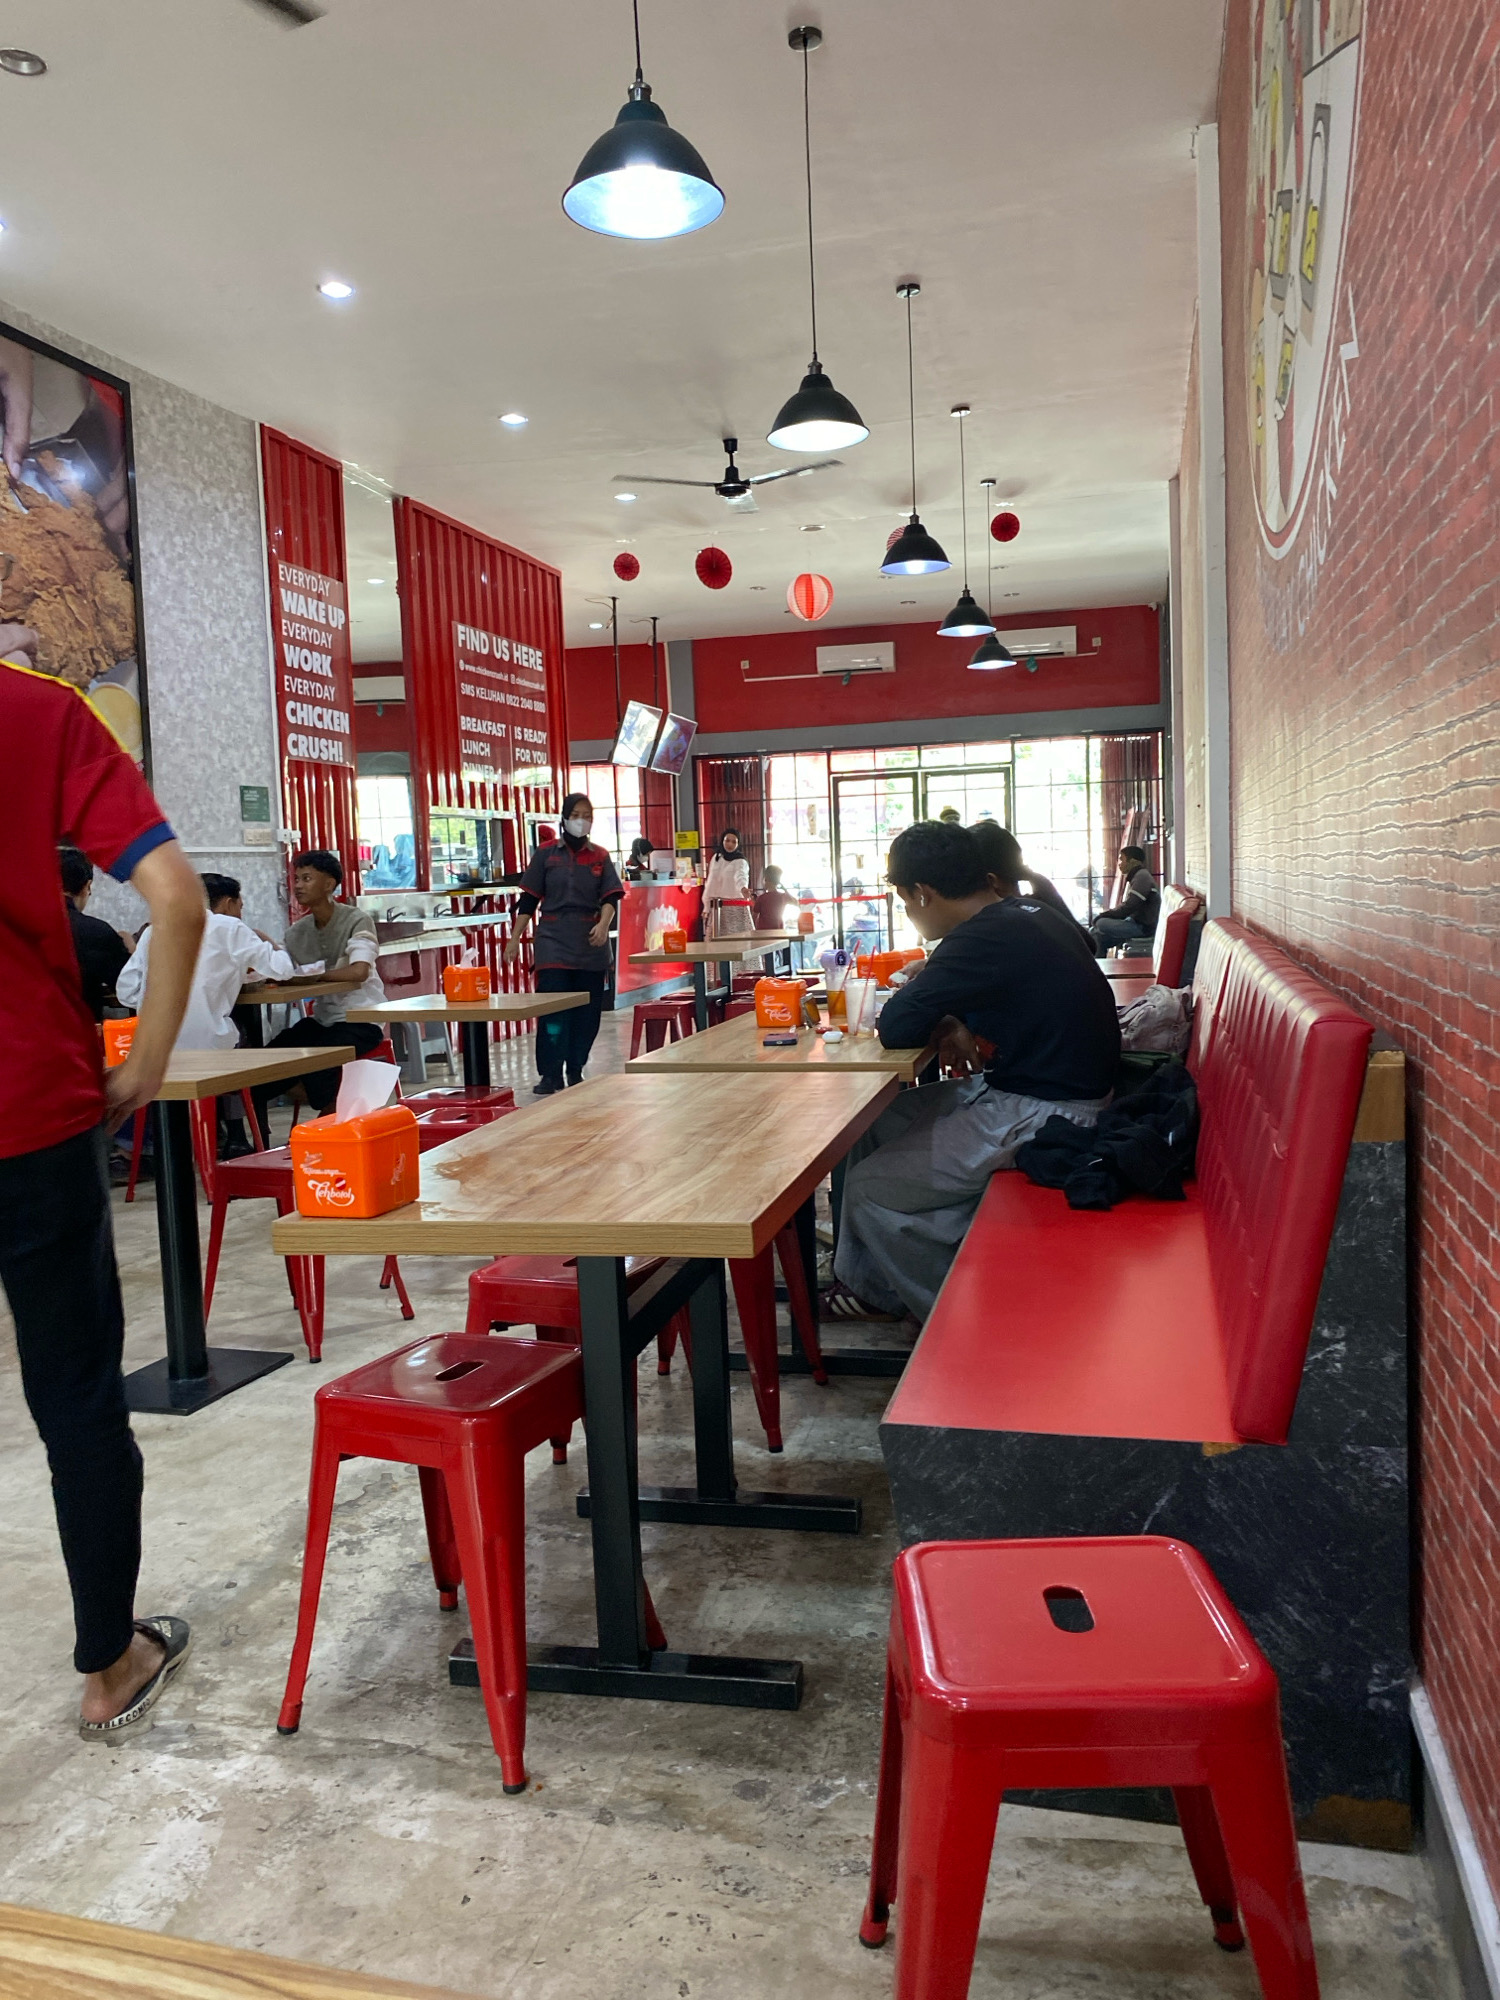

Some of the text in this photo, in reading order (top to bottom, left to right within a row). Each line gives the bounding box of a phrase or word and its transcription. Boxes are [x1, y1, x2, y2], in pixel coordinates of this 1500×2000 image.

[278, 563, 331, 597] EVERYDAY
[280, 588, 346, 631] WAKE UP
[281, 618, 333, 650] EVERYDAY
[457, 624, 544, 673] FIND US HERE
[283, 643, 333, 678] WORK
[283, 674, 336, 703] EVERYDAY
[460, 682, 476, 697] SMS
[476, 687, 506, 704] KELUHAN
[285, 700, 351, 735] CHICKEN
[460, 715, 507, 738] BREAKFAST
[287, 733, 345, 764] CRUSH!
[461, 738, 491, 757] LUNCH
[514, 726, 547, 745] IS READY
[515, 747, 547, 765] FOR YOU
[462, 762, 494, 781] DINNER
